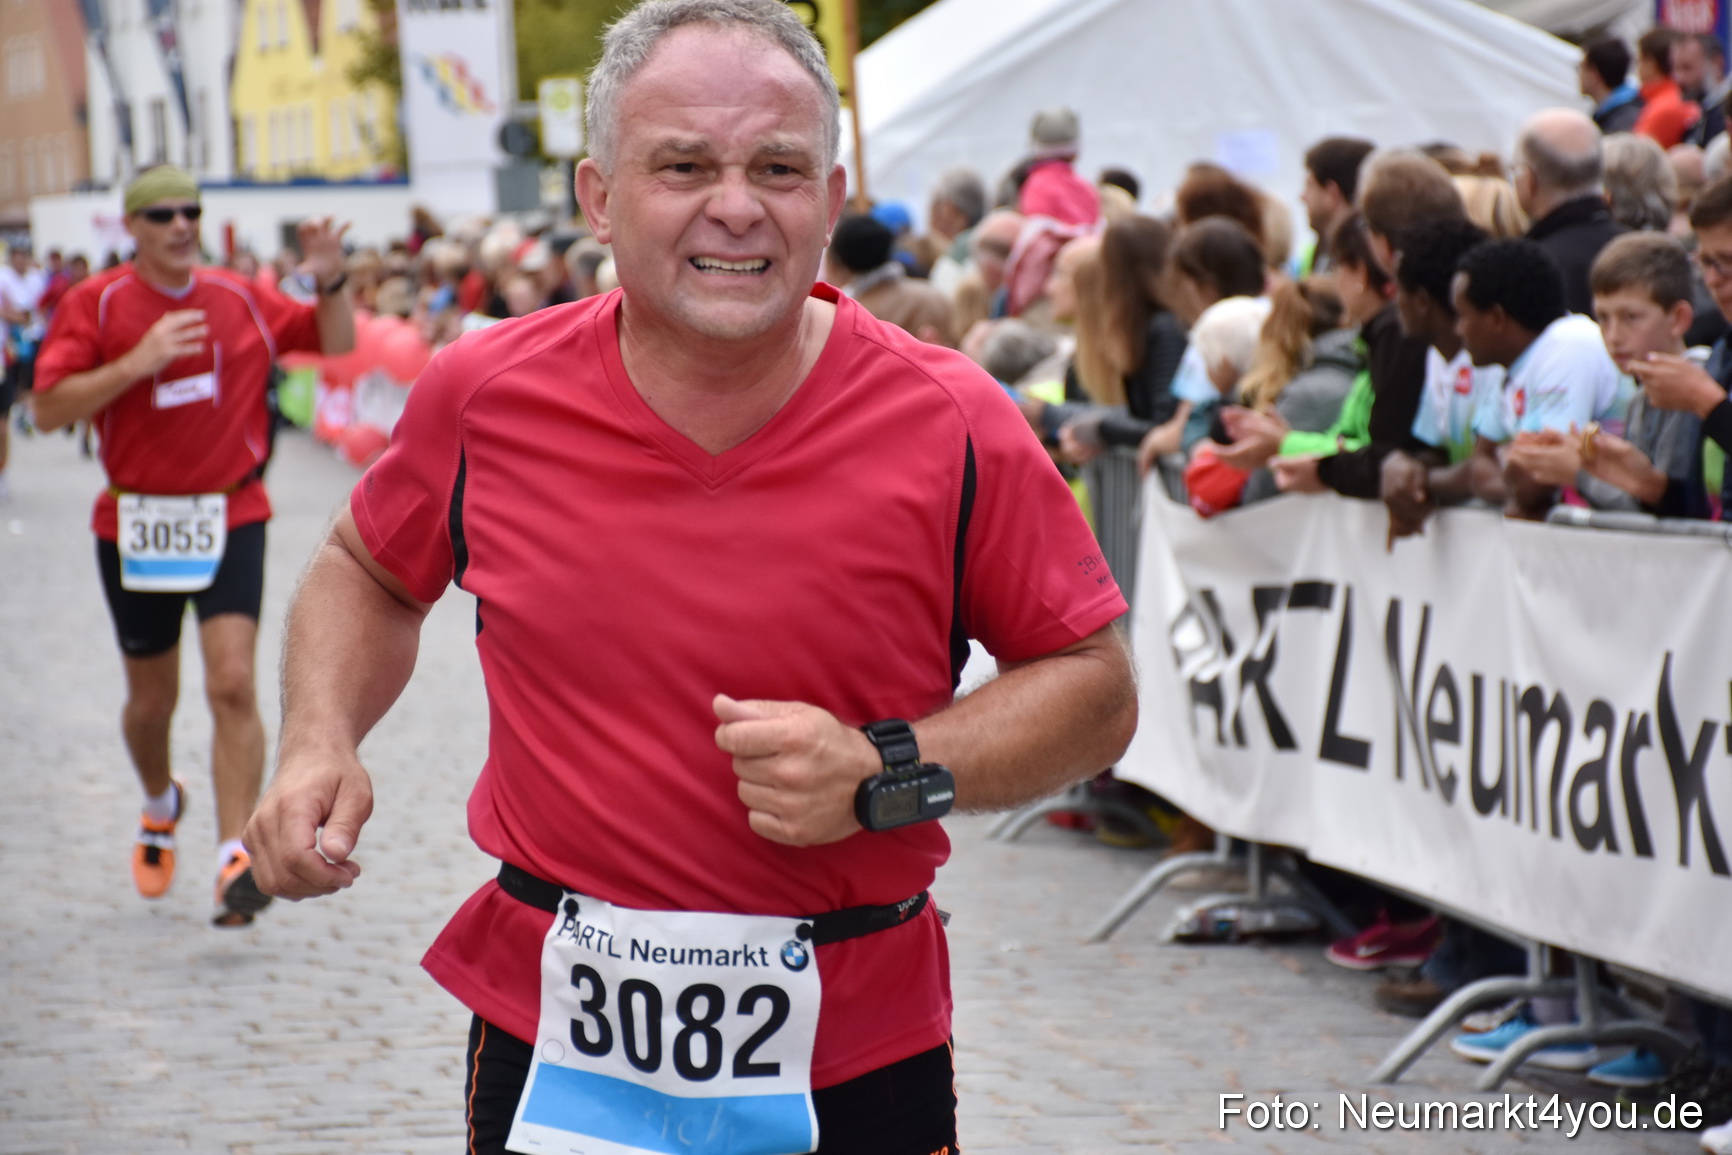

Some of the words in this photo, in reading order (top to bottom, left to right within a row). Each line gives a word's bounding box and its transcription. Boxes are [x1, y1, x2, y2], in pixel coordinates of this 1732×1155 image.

[130, 520, 214, 552] 3055
[1386, 598, 1732, 877] Neumark
[557, 914, 622, 959] PARTL
[630, 938, 769, 967] Neumarkt
[570, 963, 791, 1082] 3082
